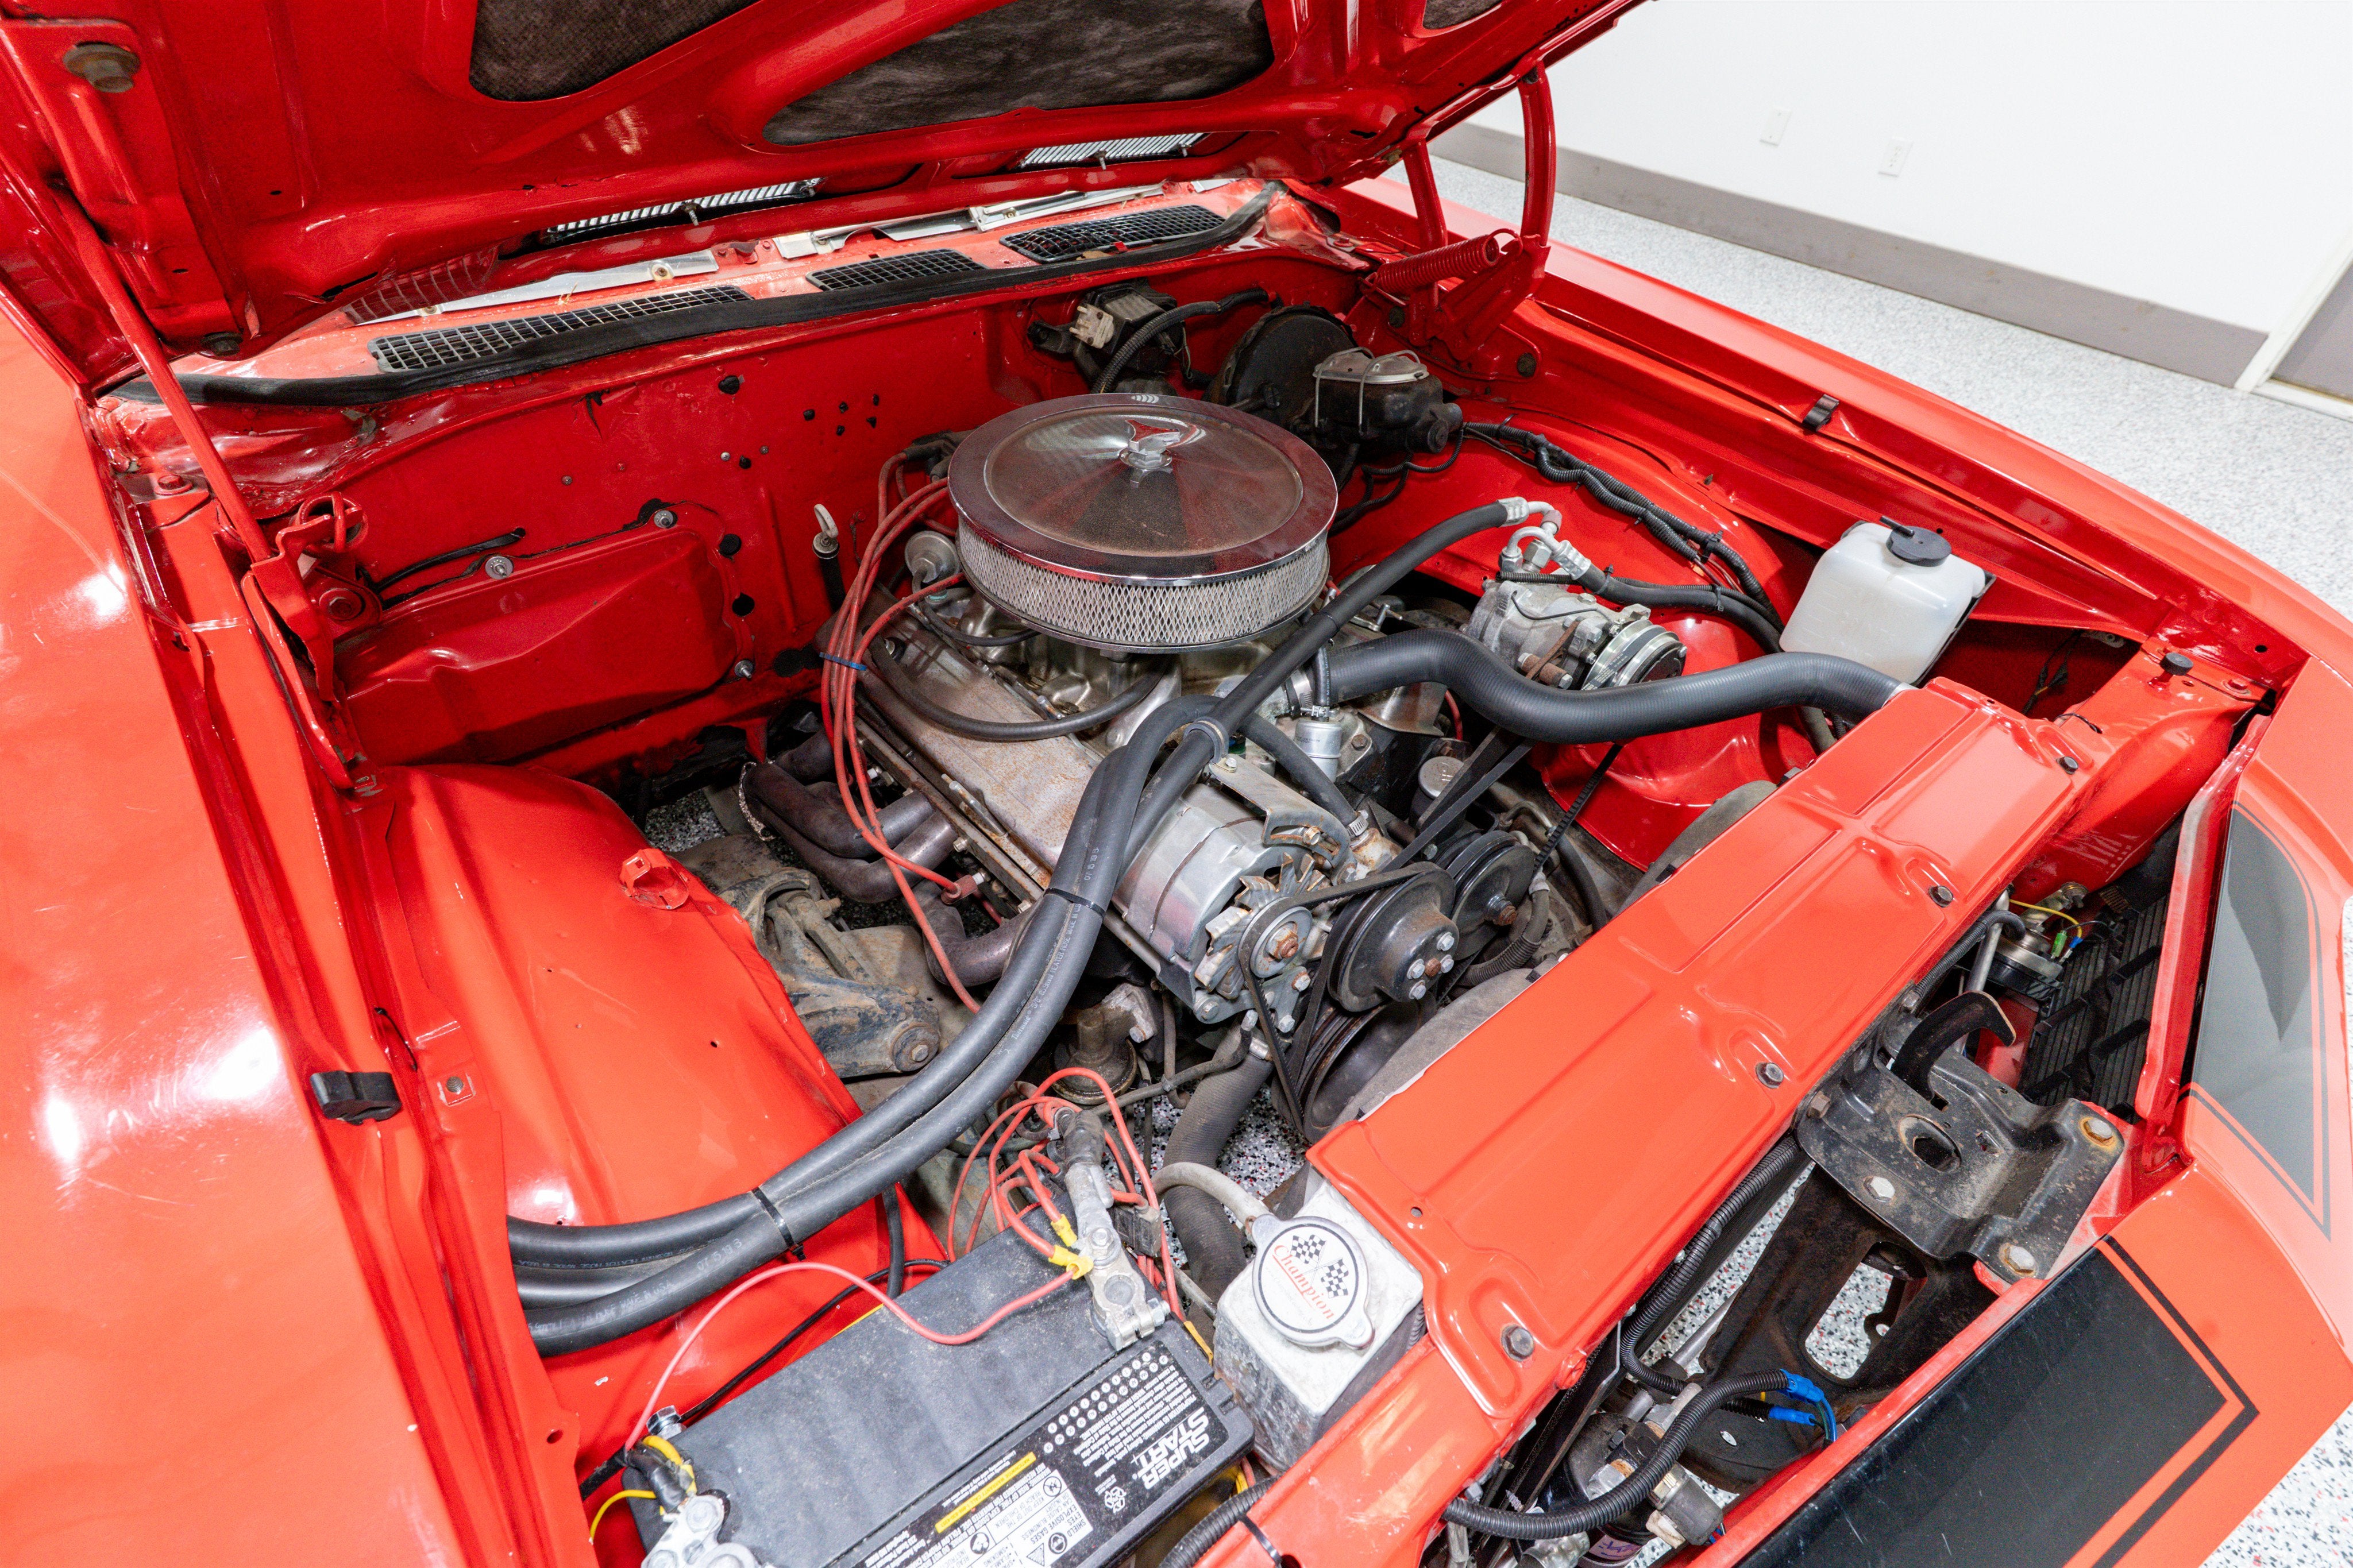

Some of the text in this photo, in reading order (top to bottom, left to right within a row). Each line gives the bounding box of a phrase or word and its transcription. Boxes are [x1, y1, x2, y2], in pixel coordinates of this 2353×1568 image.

[1063, 918, 1078, 936] MADE
[1070, 911, 1082, 922] IN
[1058, 936, 1073, 952] HOSE
[1268, 1241, 1337, 1323] Champion
[1143, 1377, 1160, 1392] cancer.
[1157, 1368, 1171, 1381] cause
[1116, 1397, 1133, 1413] HANDS
[1130, 1387, 1145, 1402] WASH
[1073, 1370, 1179, 1456] contain other chemicals known to the State of California
[1080, 1376, 1184, 1459] to cause cancer and reproductive harm. Batteries also
[1102, 1408, 1118, 1423] AFTER
[1079, 1419, 1105, 1442] HANDLING.
[1082, 1382, 1188, 1467] compounds, chemicals known to the State of California
[1104, 1388, 1192, 1460] and related accessories contain lead and lead
[1093, 1393, 1197, 1478] PROPOSITION 65 WARNING: Battery posts, terminals
[1130, 1406, 1213, 1481] START
[1139, 1426, 1213, 1492] SUPER
[969, 1457, 1030, 1505] NATIONWIDE WARRANTY CALL
[1028, 1467, 1051, 1488] WARNING:
[1010, 1491, 1019, 1501] OF
[1017, 1483, 1029, 1496] RISK
[1018, 1489, 1041, 1510] REACH OF
[1061, 1491, 1069, 1500] OR
[920, 1462, 1046, 1562] NOT RECOMMENDED FOR INVERTED USE. FOLLOW PROPER
[998, 1496, 1012, 1510] FIRE,
[1005, 1495, 1044, 1529] KEEP OUT OF THE
[973, 1505, 1000, 1530] EXPLOSION
[1021, 1496, 1073, 1541] CAN CAUSE BLINDNESS
[1029, 1503, 1077, 1544] EXPLOSIVE GASES
[1066, 1517, 1086, 1538] SHIELD
[948, 1530, 969, 1549] BURNS.
[966, 1525, 975, 1535] OR
[931, 1550, 943, 1563] NOT
[940, 1544, 950, 1555] DO
[983, 1546, 1006, 1567] SMOKING
[955, 1554, 970, 1568] READ
